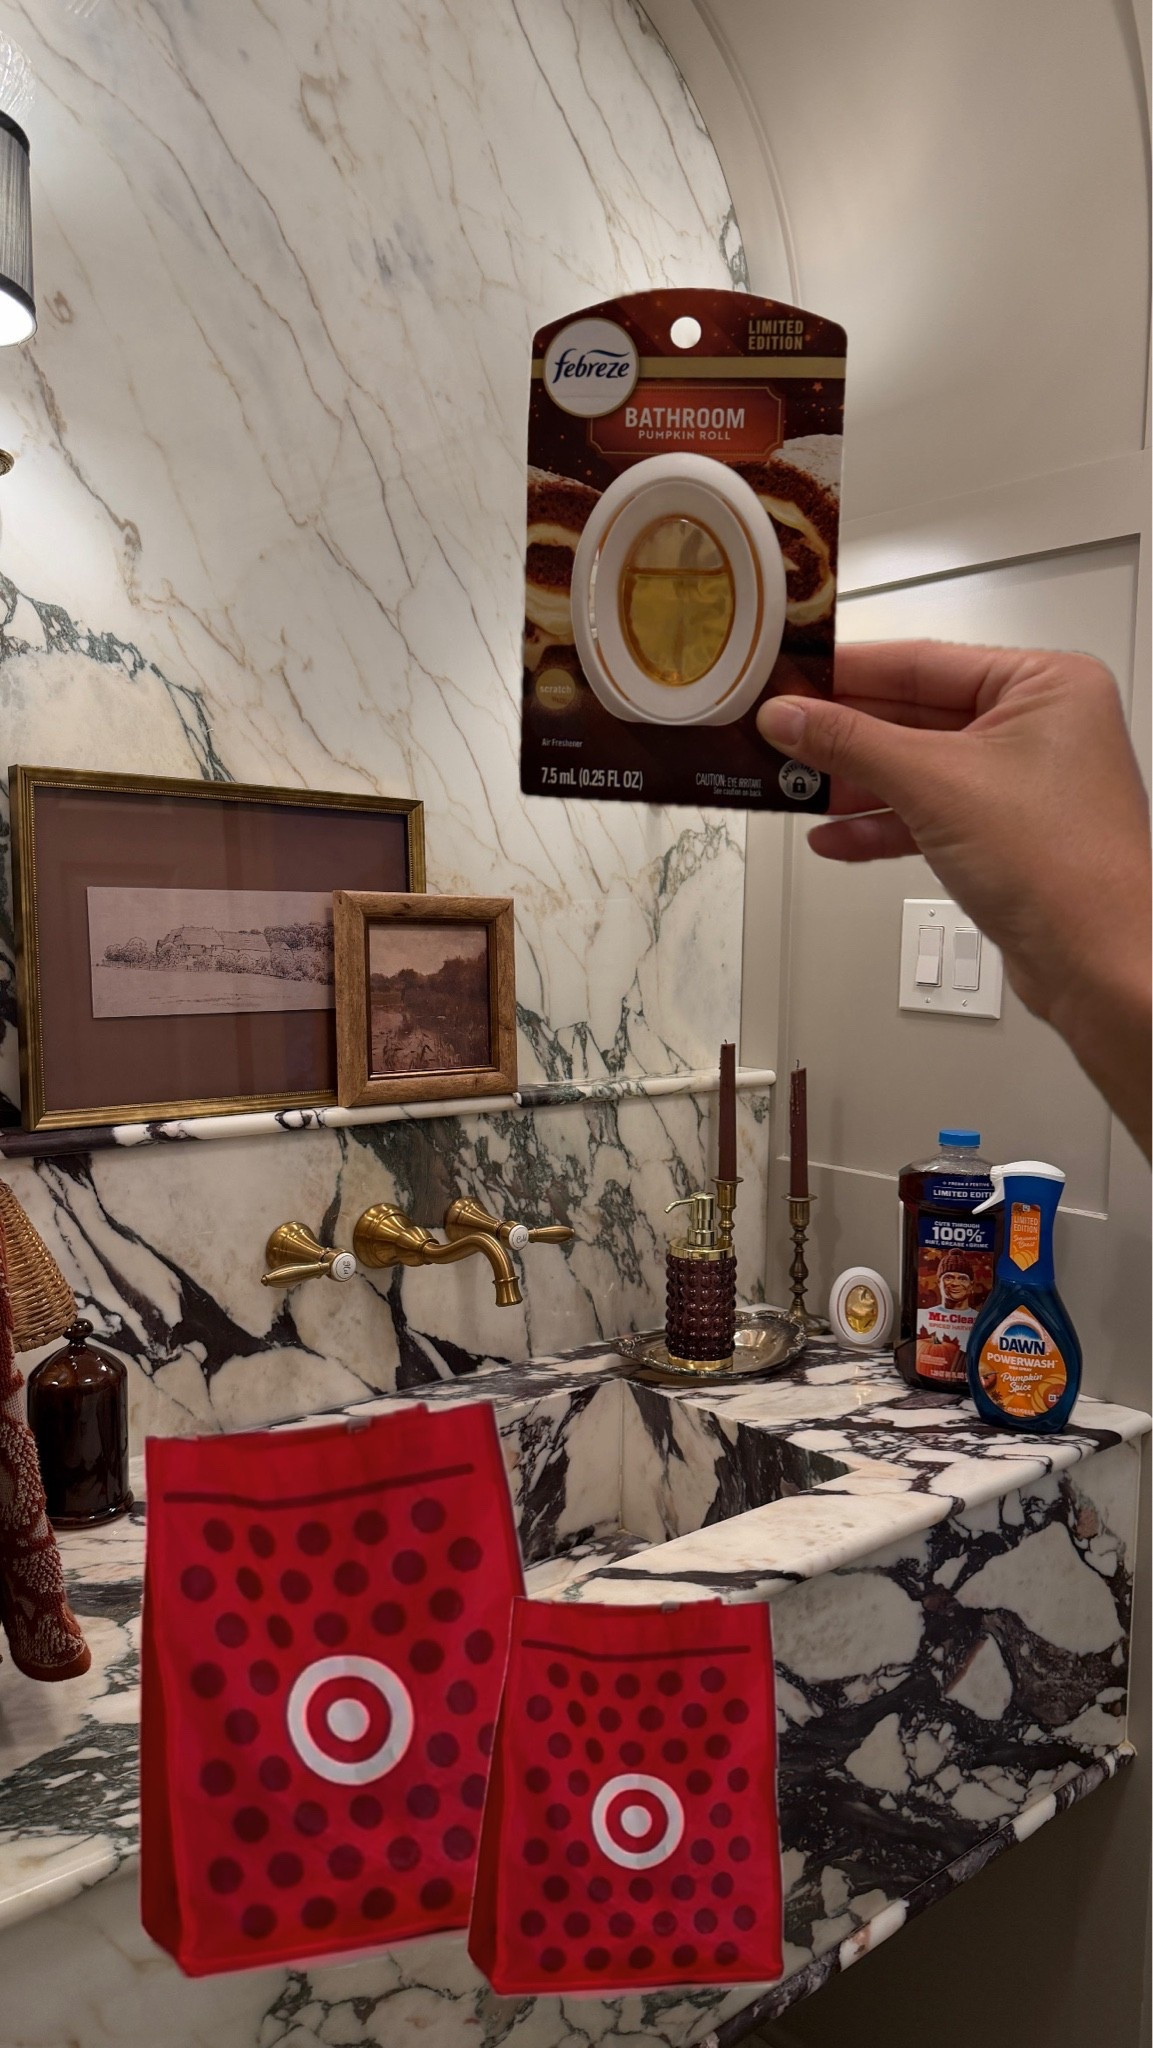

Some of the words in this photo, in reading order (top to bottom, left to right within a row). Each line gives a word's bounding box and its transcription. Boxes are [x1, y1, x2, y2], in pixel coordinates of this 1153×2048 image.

[748, 319, 804, 335] LIMITED
[748, 335, 803, 350] EDITION
[552, 347, 630, 384] febreze
[625, 407, 745, 429] BATHROOM
[638, 430, 695, 440] PUMPKIN
[699, 431, 731, 441] ROLL
[539, 685, 572, 694] scratch
[541, 737, 551, 746] Air
[551, 738, 583, 748] Freshener
[541, 767, 558, 784] 7.5
[559, 768, 577, 785] mL
[579, 768, 605, 788] (0.25
[607, 770, 621, 787] FL
[623, 770, 644, 791] OZ)
[695, 772, 727, 787] CAUTION:
[727, 777, 738, 788] EYE
[933, 1189, 968, 1198] LIMITED
[1013, 1216, 1038, 1226] LIMITED
[932, 1226, 982, 1243] 100%
[1013, 1224, 1038, 1234] EDITION
[949, 1314, 976, 1324] Clea
[999, 1336, 1046, 1355] DAWN
[987, 1352, 1056, 1369] POWERWASH
[1000, 1371, 1043, 1383] Pumpkin
[1009, 1382, 1032, 1393] Spice
